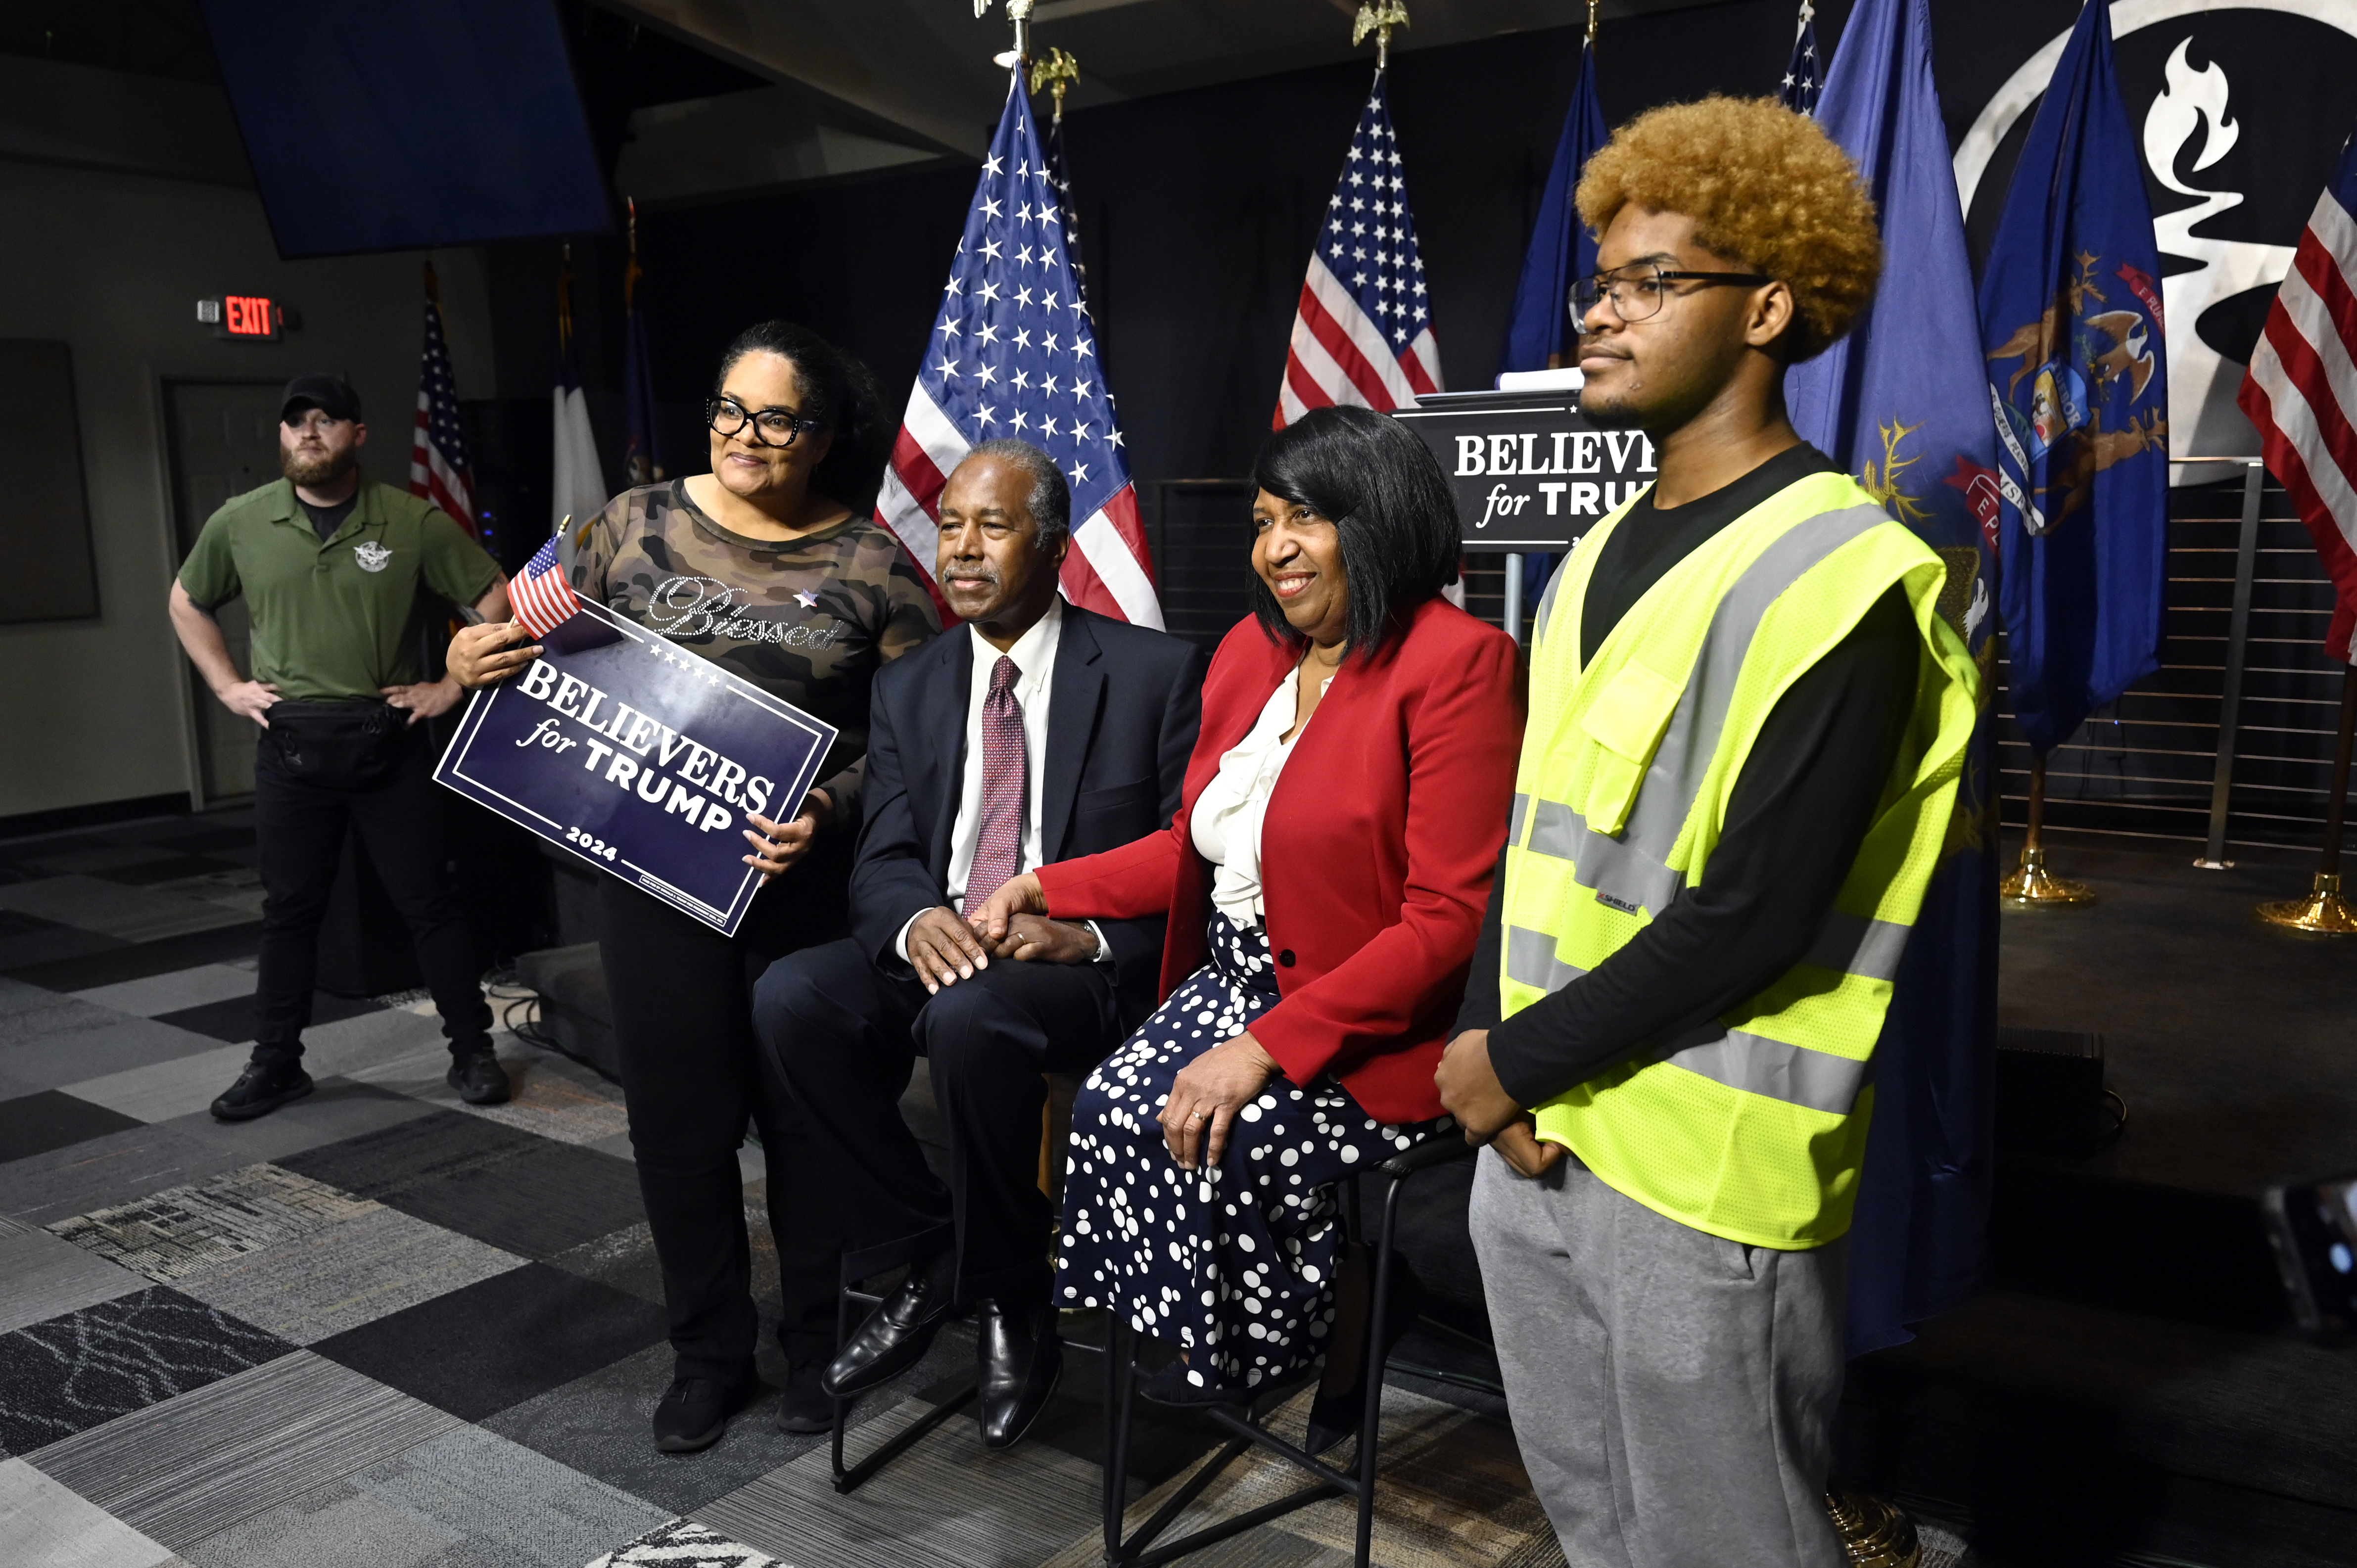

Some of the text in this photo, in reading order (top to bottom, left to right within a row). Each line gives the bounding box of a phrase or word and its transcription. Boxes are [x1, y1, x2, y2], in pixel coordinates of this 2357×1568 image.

[226, 296, 271, 335] EXIT
[1476, 481, 1653, 528] for TRU
[649, 576, 848, 651] Blessed
[516, 658, 775, 815] BELIEVERS
[516, 719, 732, 833] for TRUMP
[566, 827, 617, 862] 2024
